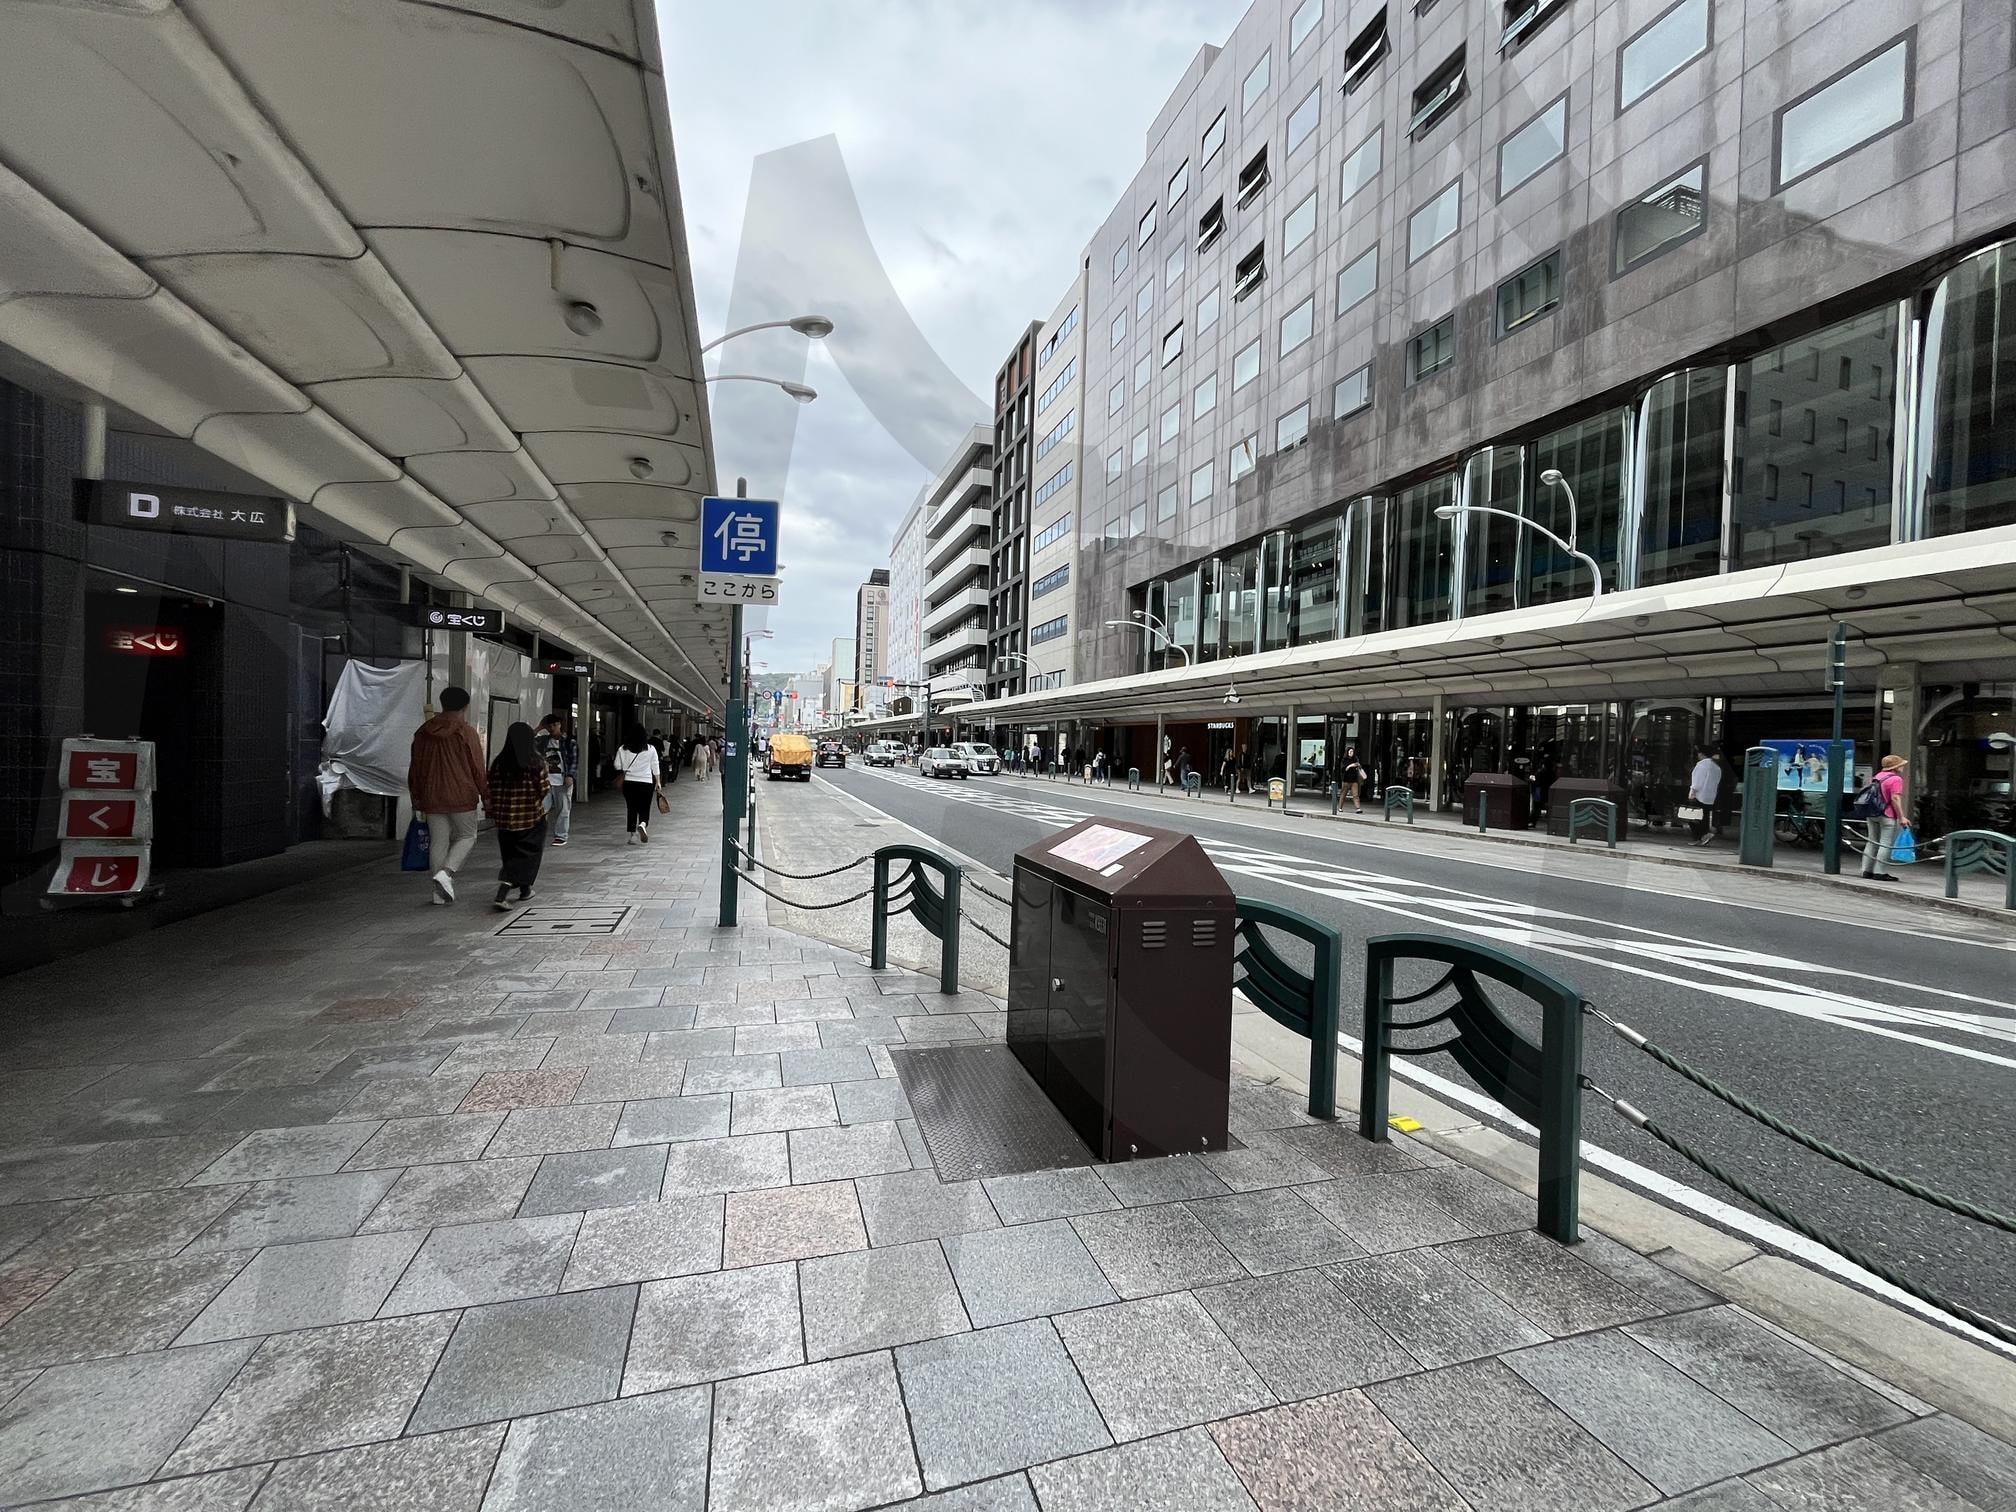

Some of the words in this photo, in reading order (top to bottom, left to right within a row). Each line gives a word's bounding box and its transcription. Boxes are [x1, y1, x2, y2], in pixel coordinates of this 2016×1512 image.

[173, 505, 224, 520] 株式会社
[231, 509, 265, 524] 大広
[714, 511, 766, 562] 停
[704, 580, 775, 599] ここから
[447, 613, 486, 627] 宝くじ
[1207, 721, 1235, 730] STARBUCKS
